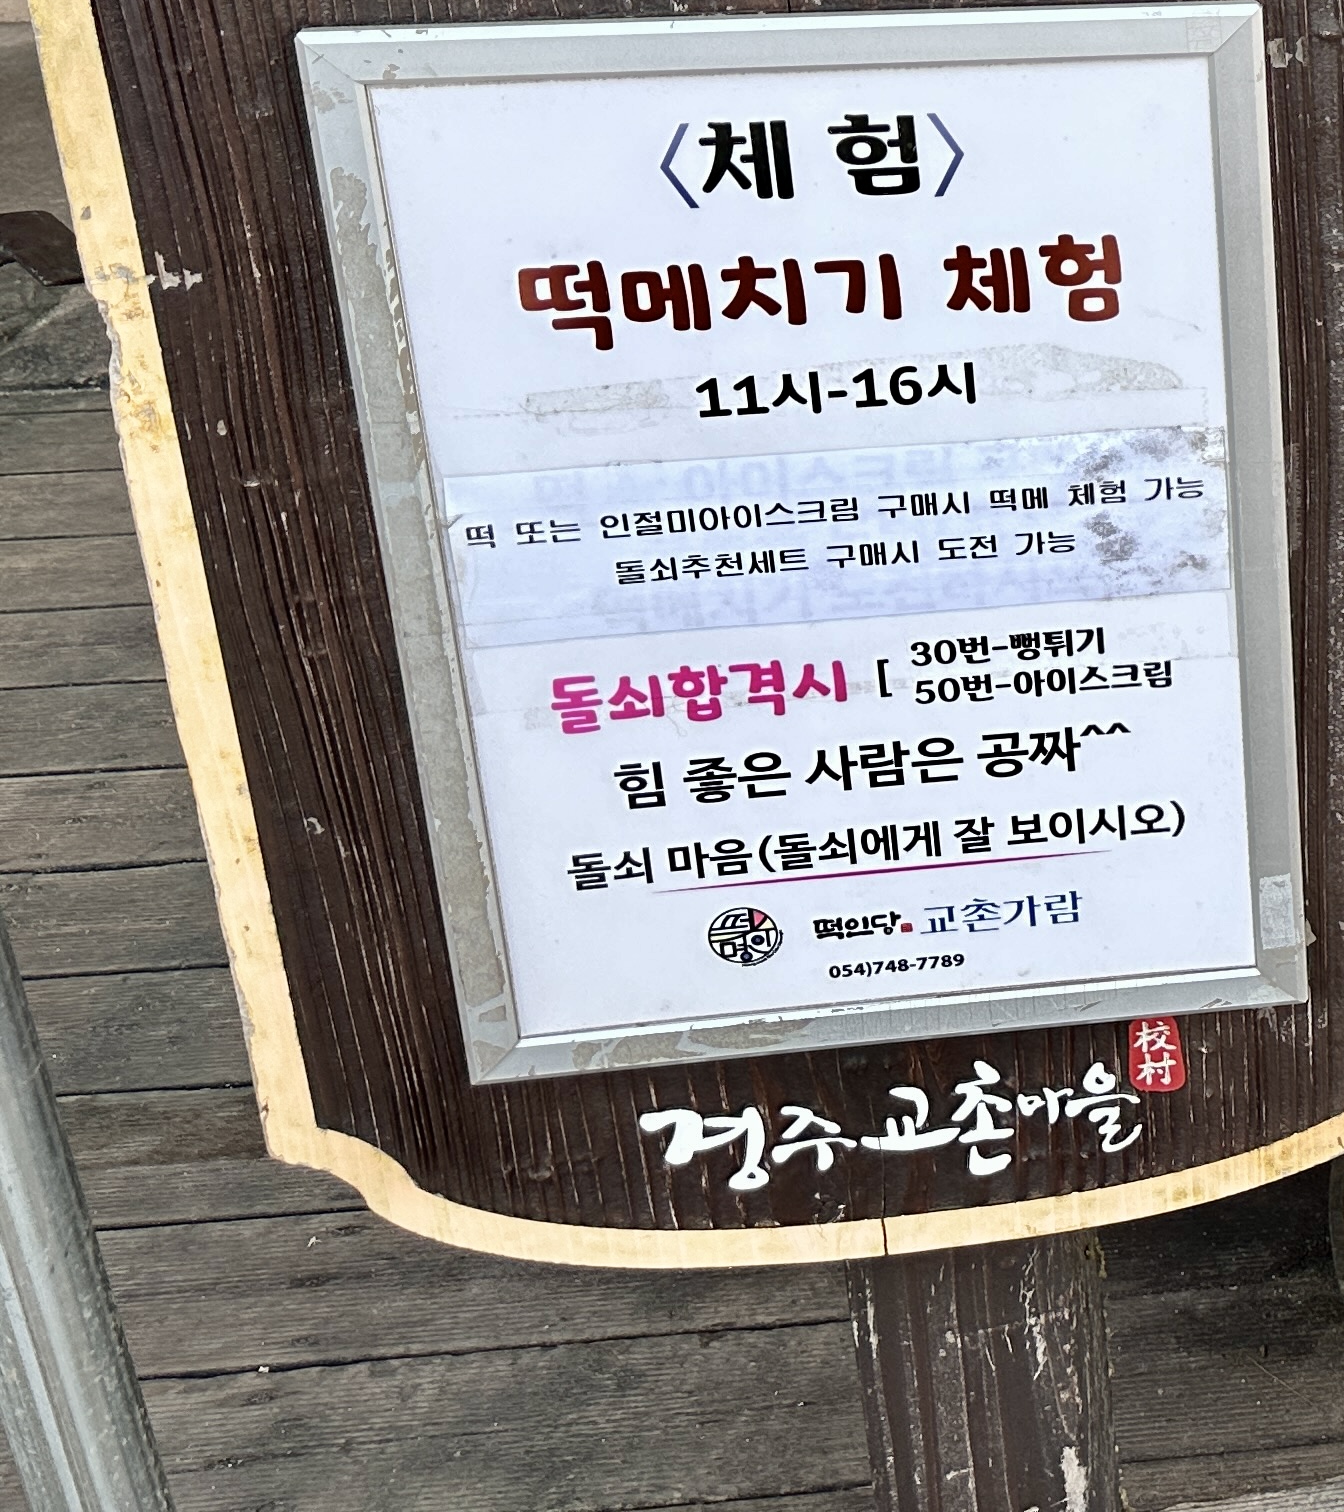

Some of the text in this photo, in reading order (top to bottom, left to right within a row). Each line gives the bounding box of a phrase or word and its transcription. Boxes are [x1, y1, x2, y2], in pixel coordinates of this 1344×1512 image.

[517, 233, 1123, 351] 떡메치기 체험
[695, 361, 978, 418] 11시-16시
[465, 476, 1206, 549] 떡 또는 인절미아이스크림 구매시 떡메 체험 가능
[614, 530, 1078, 586] 돌쇠추천세트 구매시 도전 가능
[909, 626, 1107, 667] 30번-뻥튀기
[549, 658, 850, 736] 돌쇠합격시
[913, 660, 1175, 707] 50번-아이스크림
[613, 760, 668, 811] 힘
[682, 750, 793, 806] 좋은
[804, 735, 965, 791] 사람은
[566, 799, 1187, 891] 돌쇠 마음(돌쇠에게 잘 보이시오)
[812, 889, 1085, 941] 떡인당 교촌가람
[827, 952, 966, 979] 054)748-7789
[1131, 1020, 1179, 1086] 校村
[640, 1059, 1144, 1191] 경주 교촌마을
